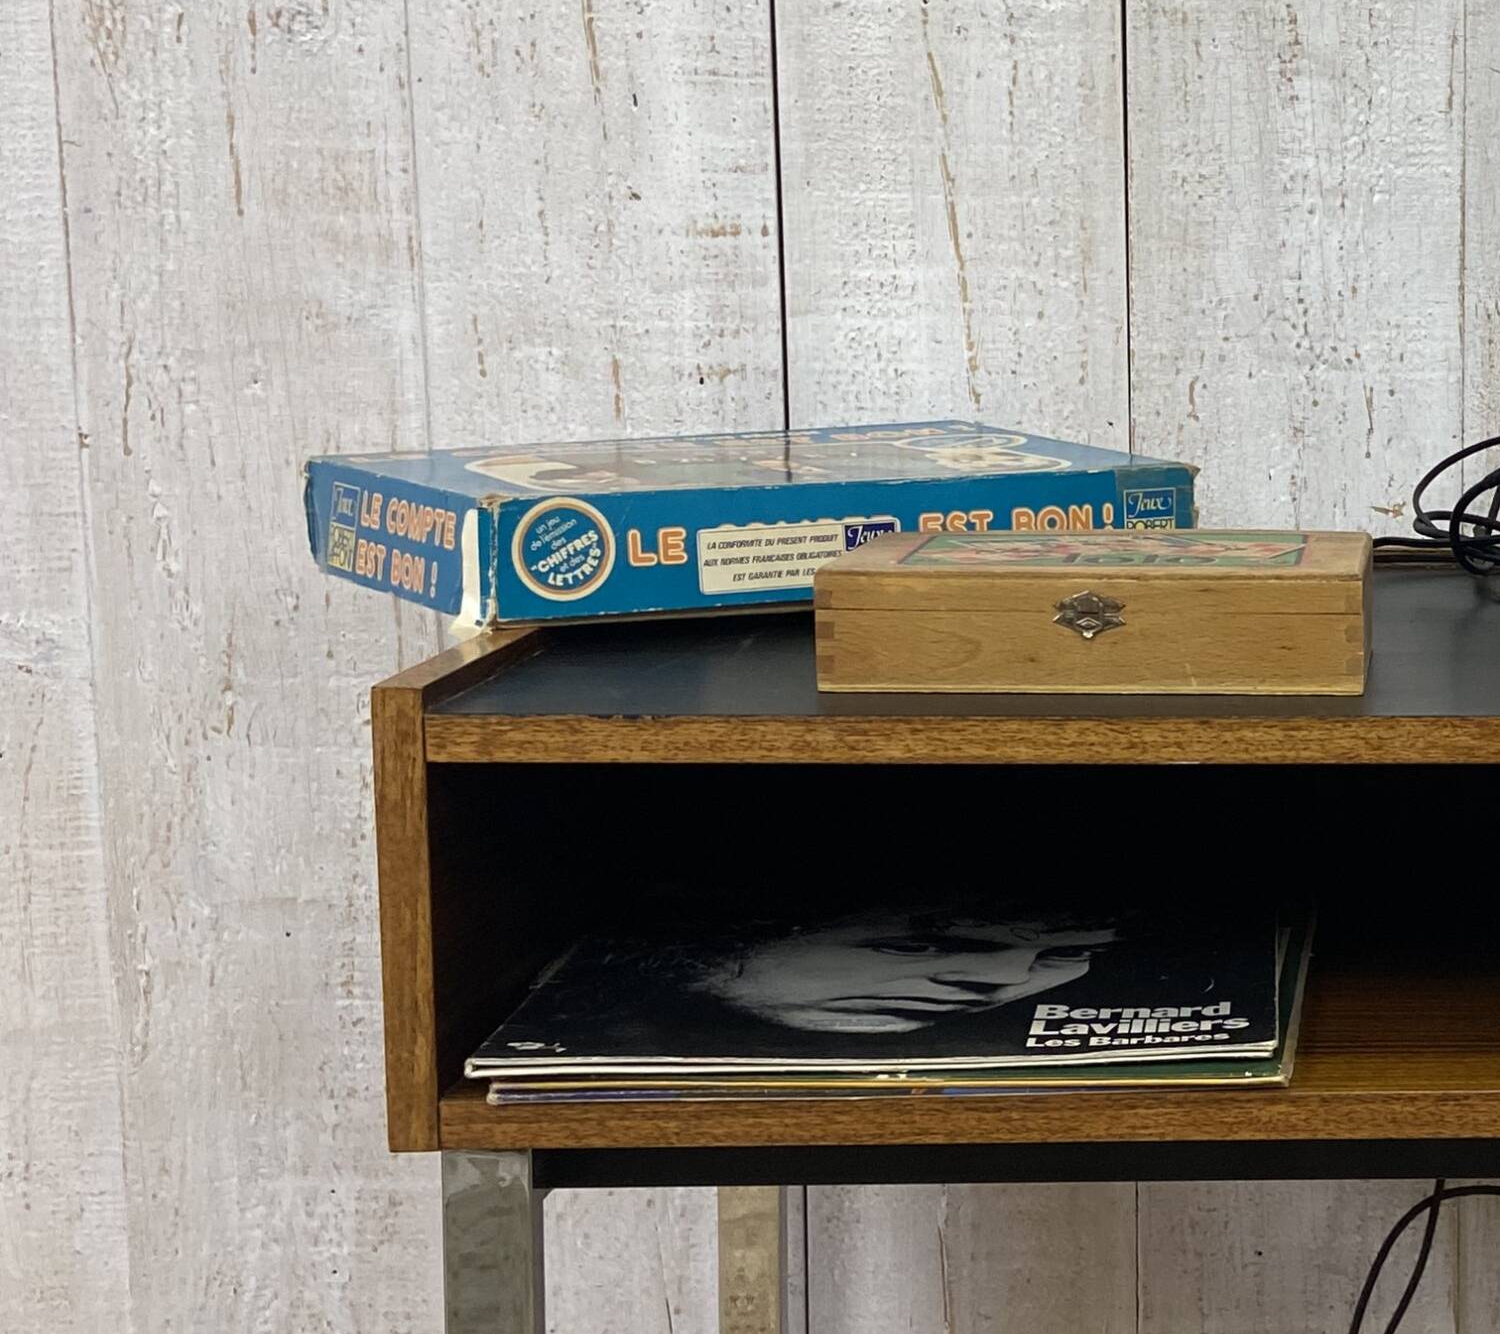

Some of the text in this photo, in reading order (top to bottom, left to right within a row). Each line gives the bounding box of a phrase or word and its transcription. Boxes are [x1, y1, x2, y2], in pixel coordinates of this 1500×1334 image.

[360, 490, 383, 530] LE
[386, 497, 457, 550] COMPTE
[628, 528, 688, 566] LE
[707, 541, 717, 550] LA
[764, 537, 776, 548] DU
[777, 535, 808, 547] PRESENT
[355, 539, 386, 581] EST
[390, 549, 425, 594] BON
[703, 558, 719, 567] AUX
[720, 556, 750, 566] NORMES
[796, 550, 843, 562] OBLIGATOIRES
[732, 567, 816, 582] EST GARANTIE PAR LES
[1033, 1001, 1232, 1020] Bernard
[1028, 1017, 1250, 1036] Lavilliers
[1025, 1032, 1230, 1047] Les Barbares
